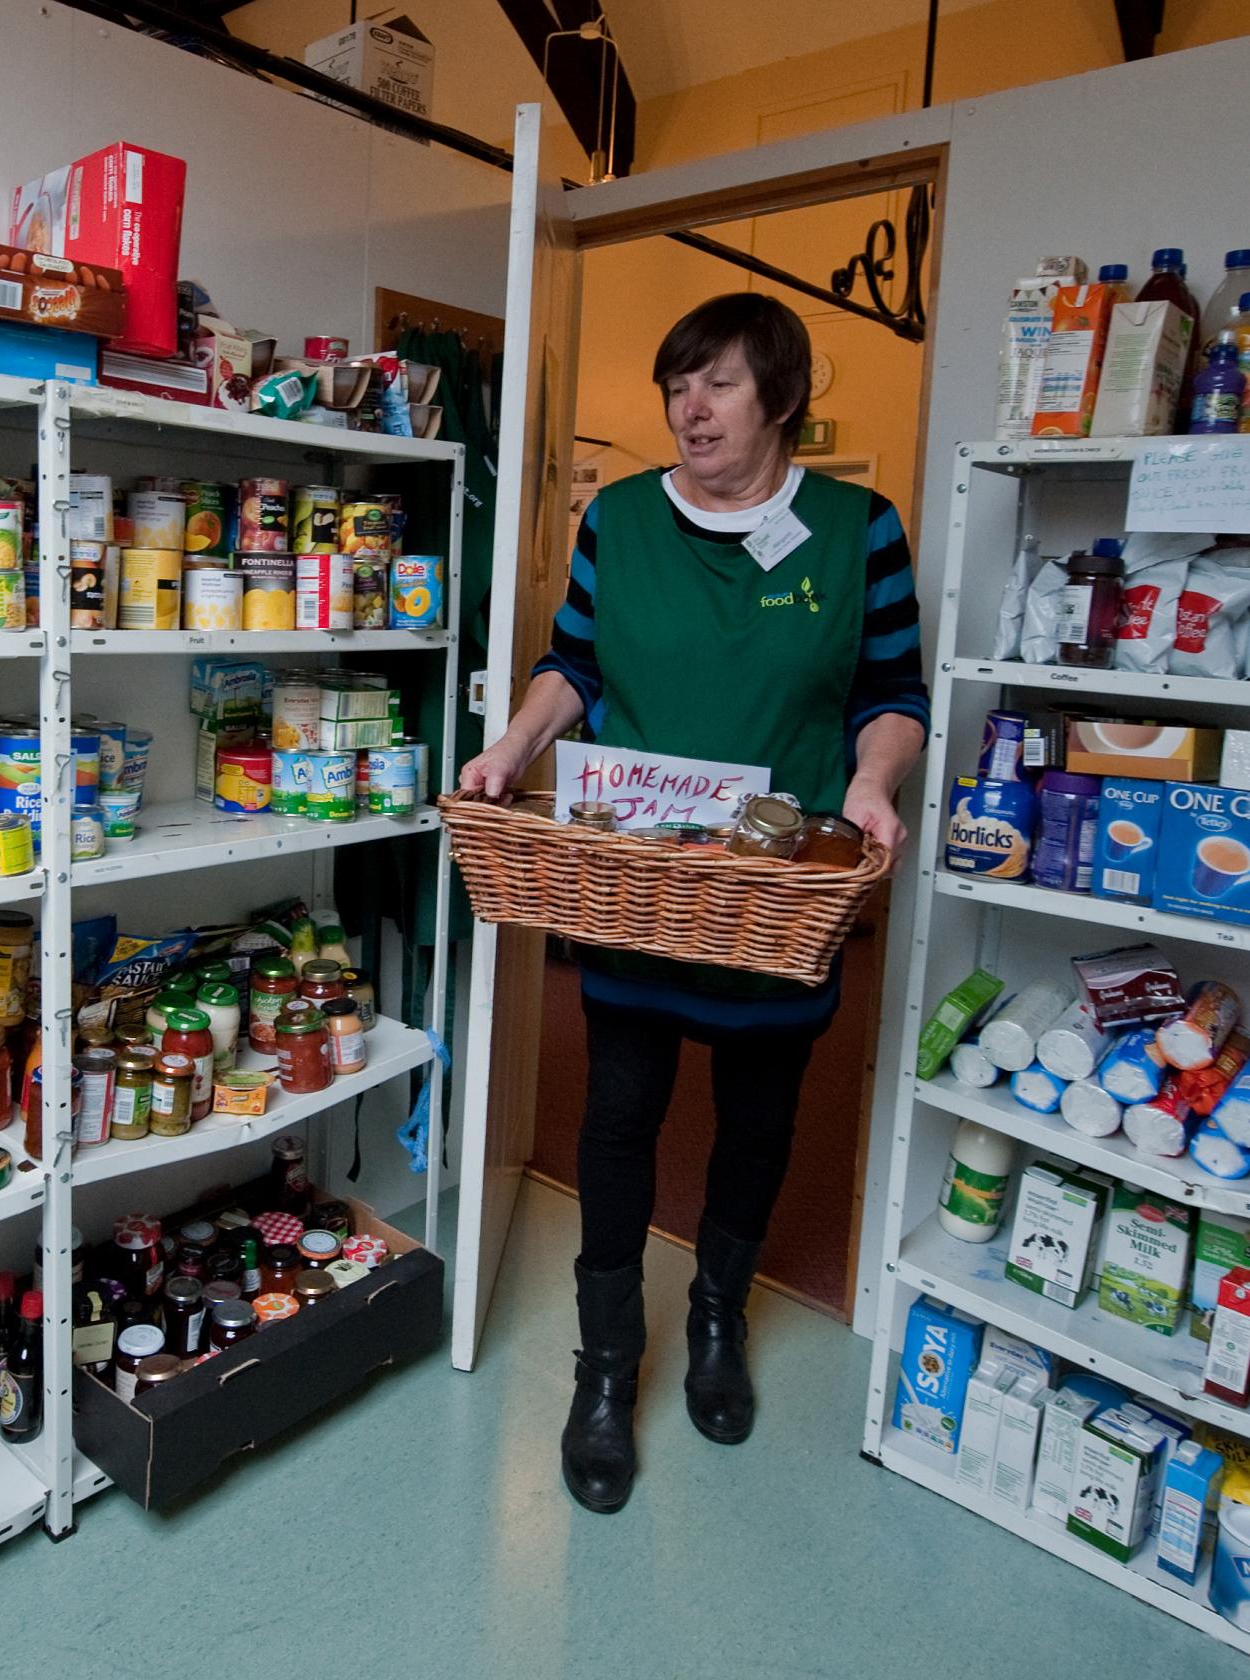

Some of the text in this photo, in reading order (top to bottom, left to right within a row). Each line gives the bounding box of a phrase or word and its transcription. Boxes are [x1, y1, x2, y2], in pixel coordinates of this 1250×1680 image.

[392, 83, 421, 101] COFFEE
[398, 96, 427, 115] PAPERS
[121, 208, 132, 257] corn flakes
[132, 223, 141, 266] co-operative
[1144, 449, 1198, 465] PLEASE
[241, 558, 295, 567] FONTINELLA
[397, 562, 425, 575] Dole
[189, 636, 205, 645] Fruit
[1050, 672, 1079, 682] Coffee
[572, 755, 744, 803] HOMEMADE
[1104, 787, 1160, 804] ONE CUP
[1169, 787, 1250, 819] ONE C
[611, 797, 697, 823] JAM
[74, 833, 96, 843] Rice
[950, 822, 1014, 850] Horlicks
[1216, 932, 1235, 942] Tea
[1130, 1217, 1167, 1239] Semi-
[1115, 1223, 1177, 1254] Skimmed
[1129, 1239, 1162, 1259] Milk
[915, 1325, 949, 1394] SOYA
[989, 1341, 1025, 1360] Everyday
